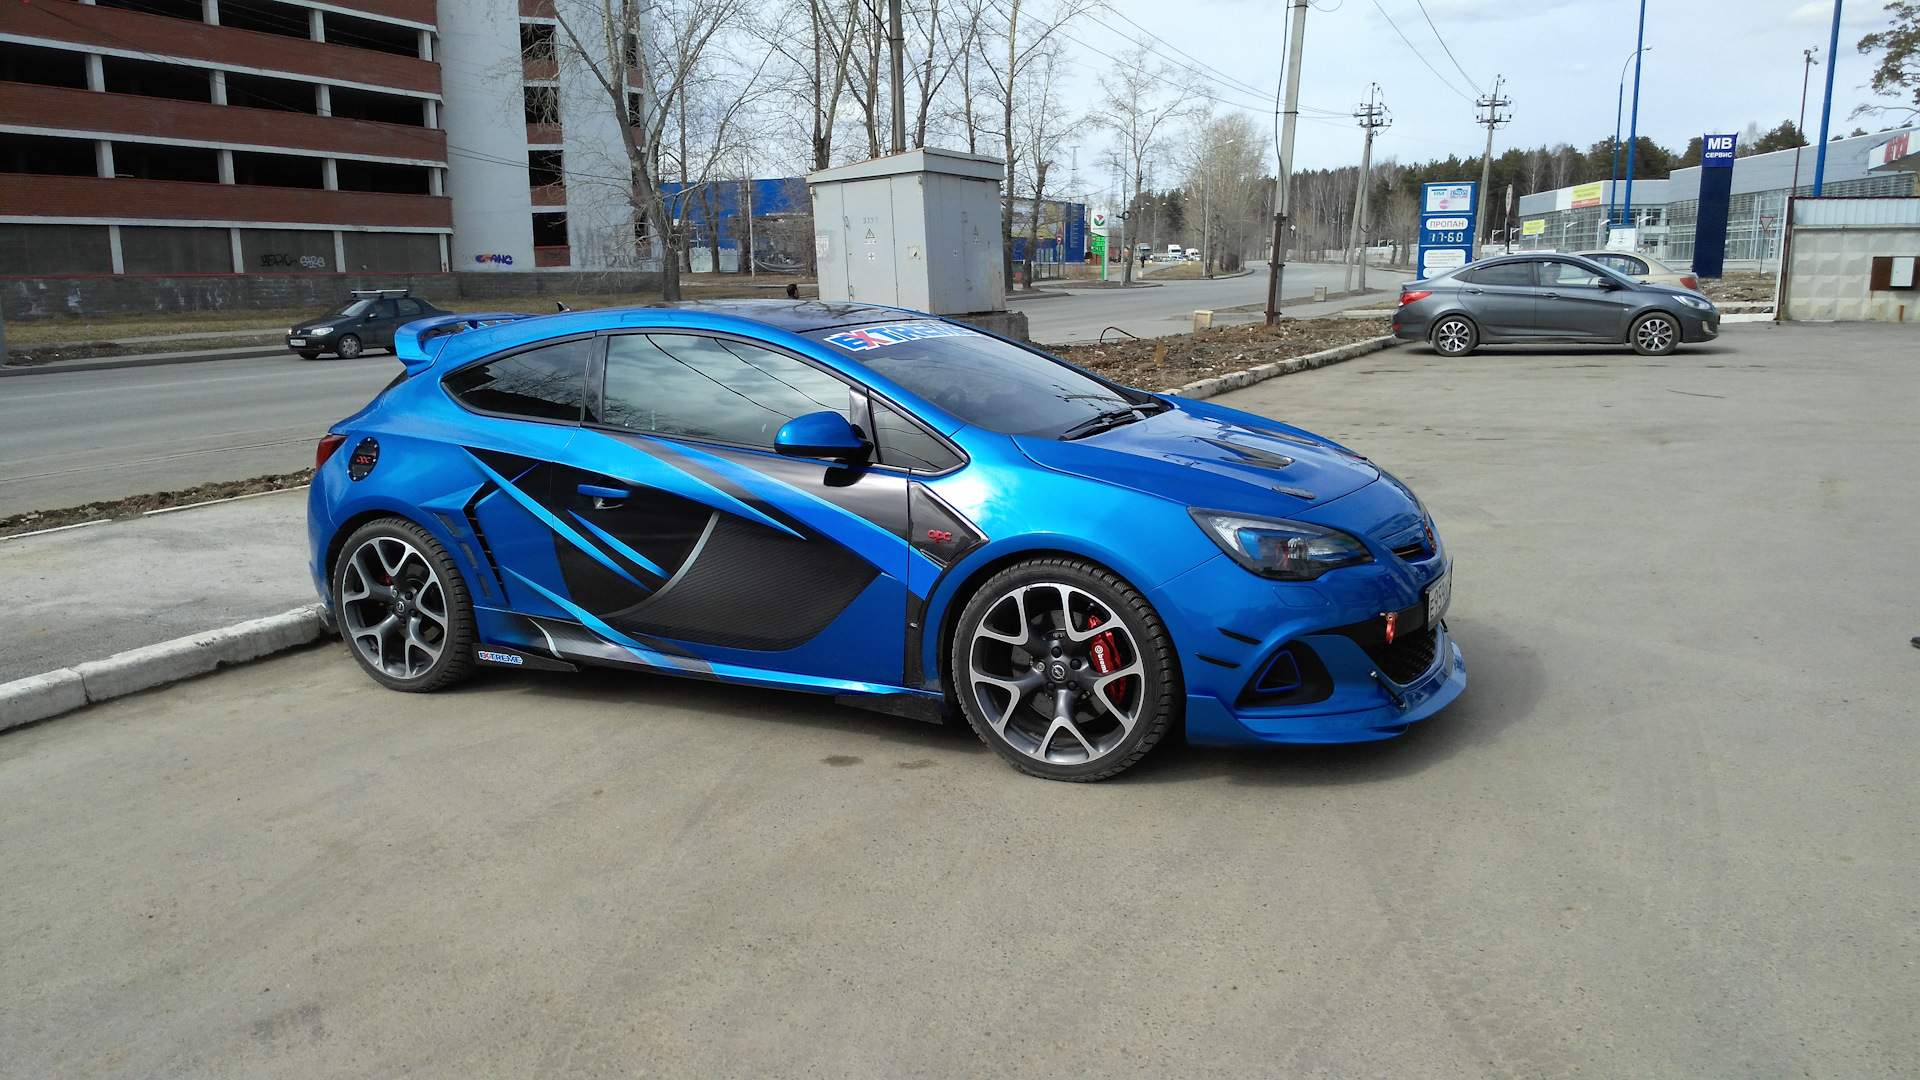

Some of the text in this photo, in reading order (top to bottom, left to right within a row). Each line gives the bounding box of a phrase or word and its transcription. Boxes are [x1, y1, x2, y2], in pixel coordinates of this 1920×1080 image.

[1430, 220, 1464, 228] ПРОПАН
[824, 323, 981, 351] EXTREME
[478, 651, 523, 664] EXTREME
